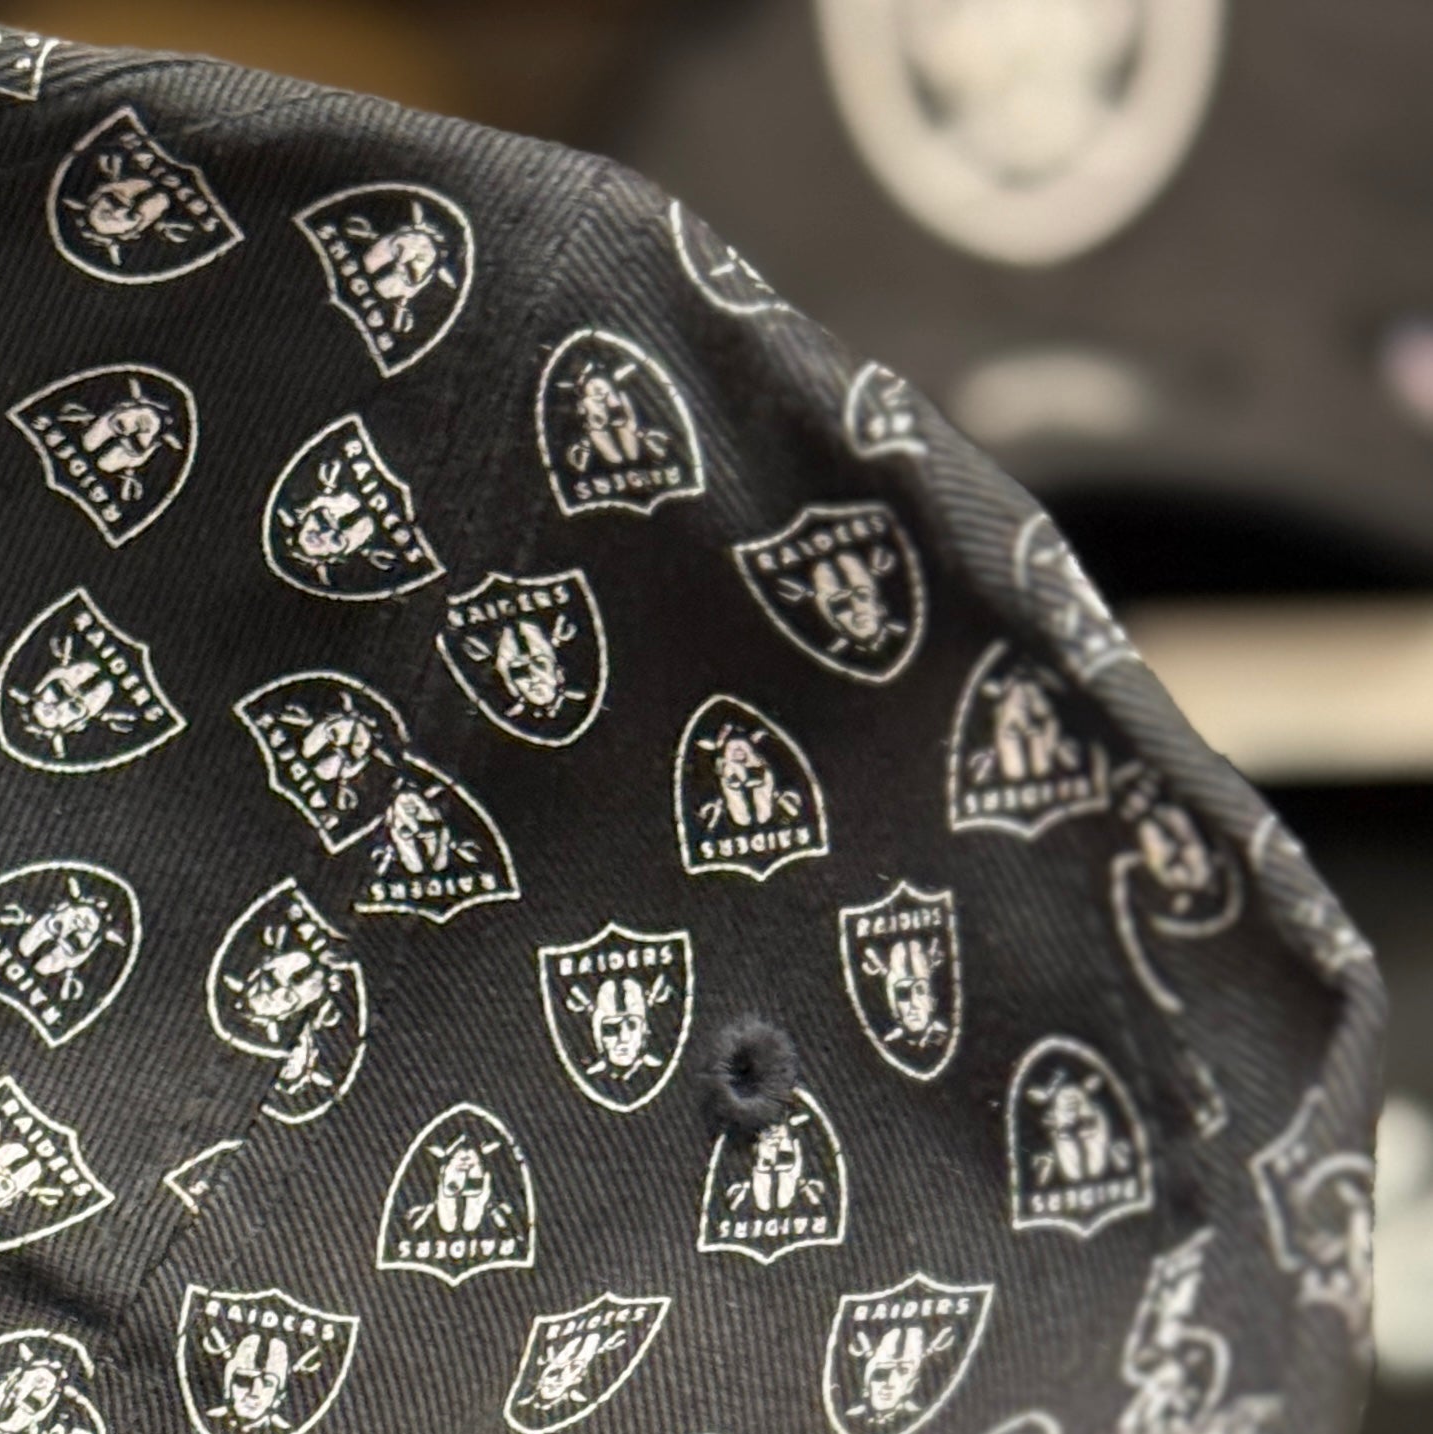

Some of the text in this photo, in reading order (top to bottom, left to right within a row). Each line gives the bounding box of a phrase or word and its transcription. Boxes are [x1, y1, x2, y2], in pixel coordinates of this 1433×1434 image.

[31, 416, 122, 522] RAIDERS
[345, 439, 424, 562] RAIDERS
[75, 611, 164, 722] RAIDERS
[701, 827, 810, 859] RAIDERS
[371, 872, 497, 902] RAIDERS
[559, 946, 673, 976] RAIDERS
[3, 1099, 92, 1197] RAIDERS
[720, 1217, 827, 1239] RAIDERS
[398, 1238, 515, 1259] RAIDERS
[206, 1301, 335, 1340] RAIDERS
[546, 1307, 647, 1339] RAIDERS
[853, 1297, 970, 1321] RAIDERS
